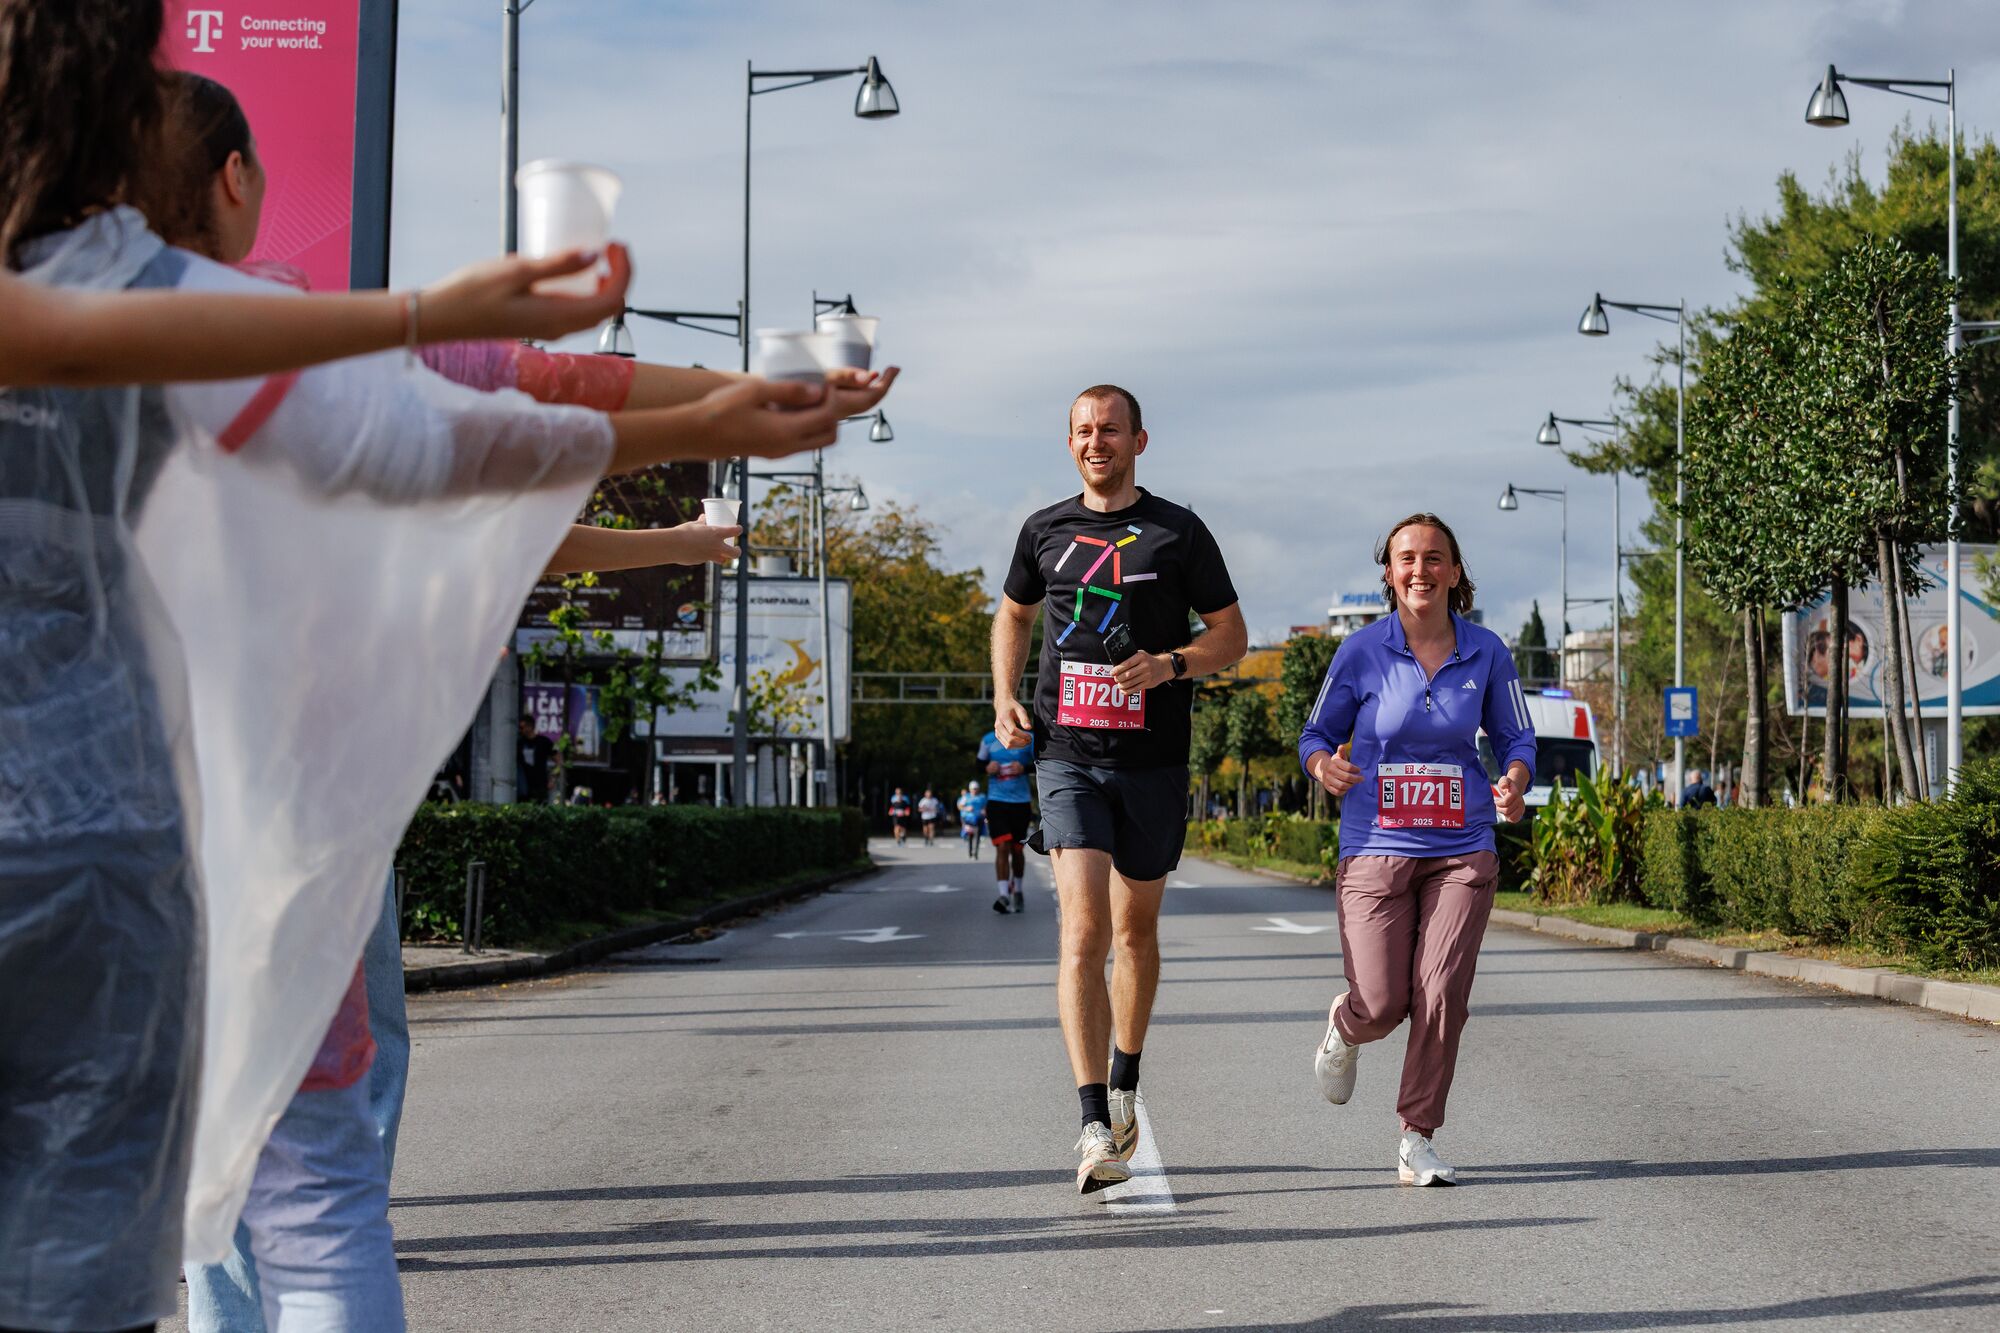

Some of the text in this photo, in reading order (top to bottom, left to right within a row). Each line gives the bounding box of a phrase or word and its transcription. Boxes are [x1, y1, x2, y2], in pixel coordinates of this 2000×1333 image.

[241, 16, 326, 34] Connecting
[241, 36, 322, 50] your world.
[1078, 681, 1125, 708] 1720
[1089, 719, 1110, 727] 2025
[1400, 782, 1444, 805] 1721
[1412, 818, 1433, 826] 2025
